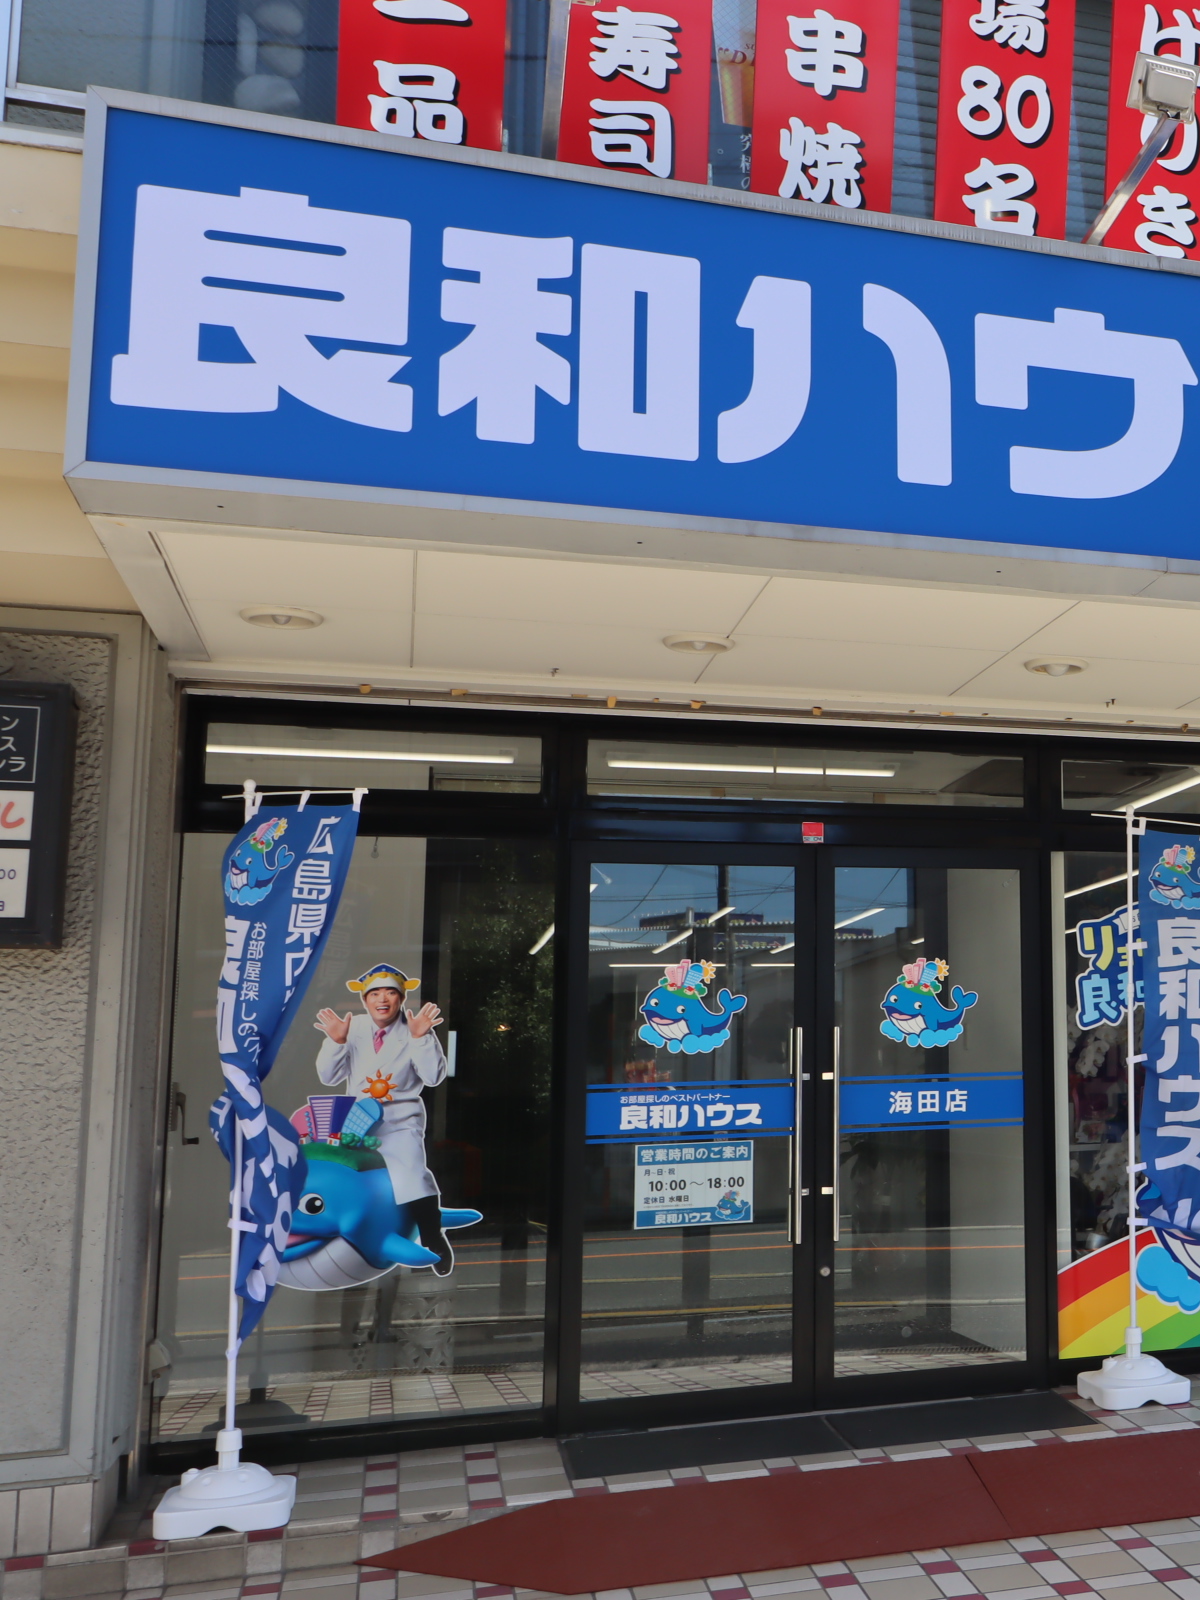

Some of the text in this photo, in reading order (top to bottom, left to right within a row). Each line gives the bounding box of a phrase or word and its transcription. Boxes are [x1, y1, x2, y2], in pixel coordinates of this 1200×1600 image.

[588, 6, 680, 178] 寿司
[778, 9, 867, 209] 串焼
[888, 1088, 968, 1115] 海田店
[619, 1103, 762, 1130] 良和ハウス
[640, 1145, 749, 1163] 営業時間のご案内
[654, 1212, 712, 1225] 良和ハウス
